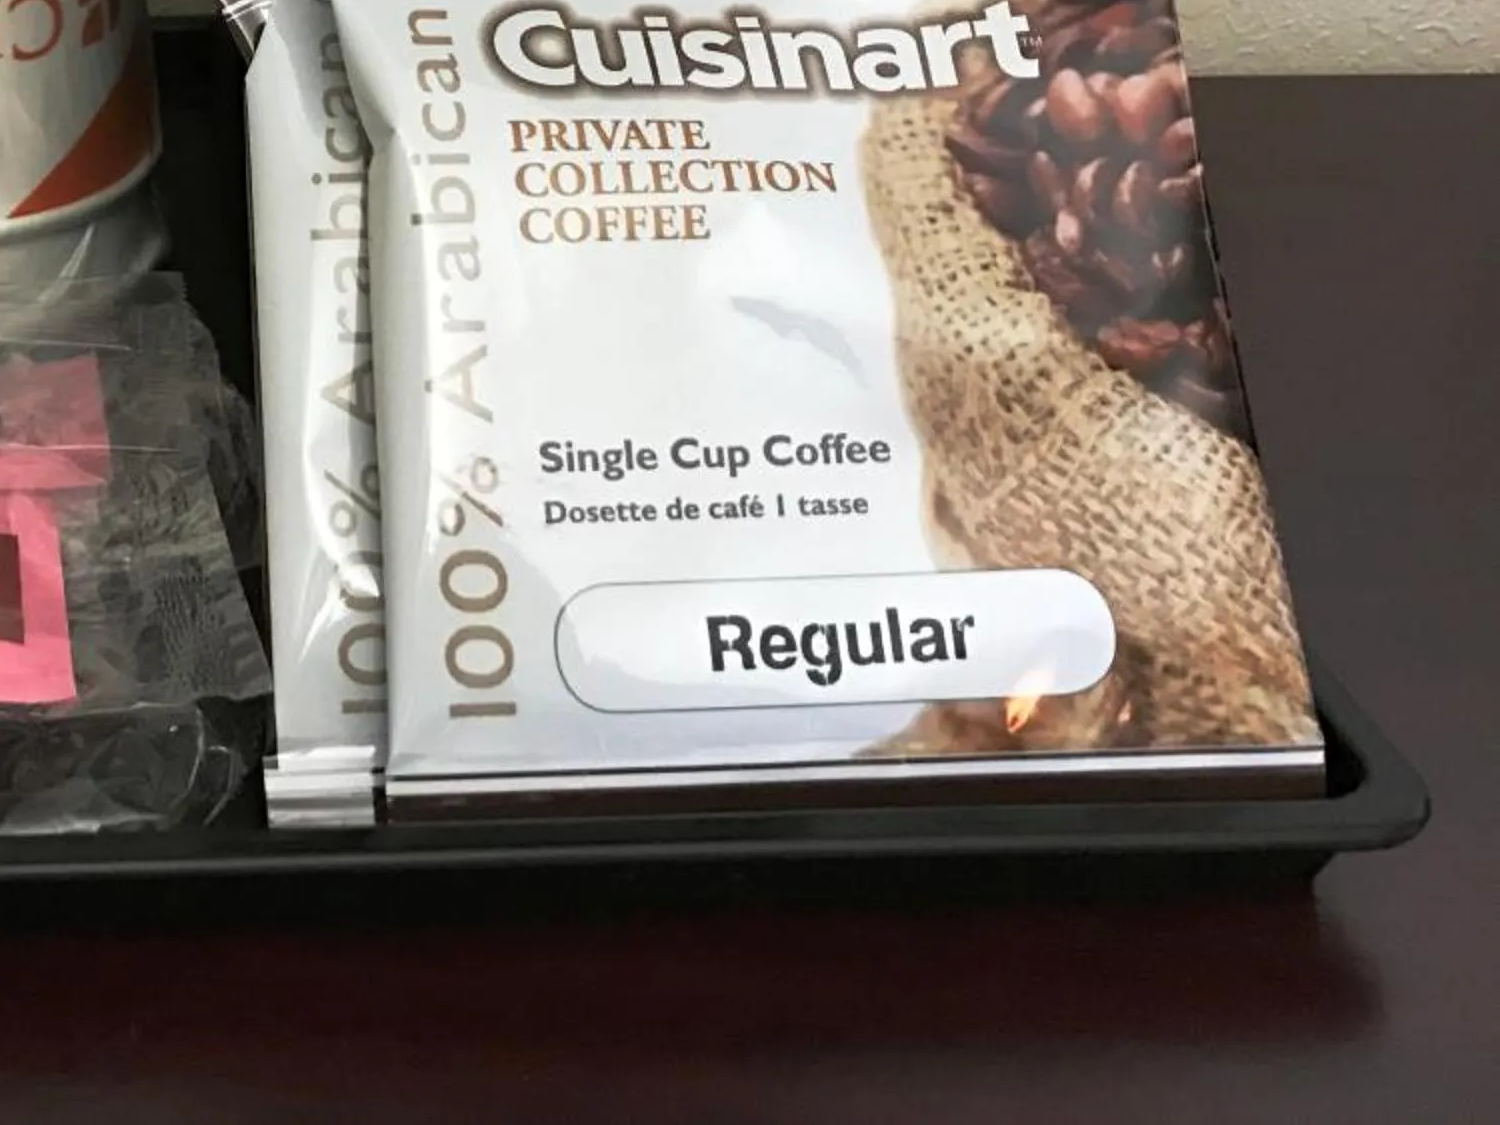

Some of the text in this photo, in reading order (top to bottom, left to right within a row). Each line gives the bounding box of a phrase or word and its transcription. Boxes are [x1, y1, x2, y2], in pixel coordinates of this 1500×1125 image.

[509, 118, 710, 153] PRIVATE
[513, 159, 838, 197] COLLECTION
[406, 7, 494, 425] Arabican
[519, 203, 712, 245] COFFEE
[537, 433, 893, 481] Single Cup Coffee
[543, 497, 659, 526] Dosette
[665, 495, 701, 522] de
[707, 493, 766, 520] café
[797, 494, 870, 518] tasse
[705, 608, 976, 687] Regular
